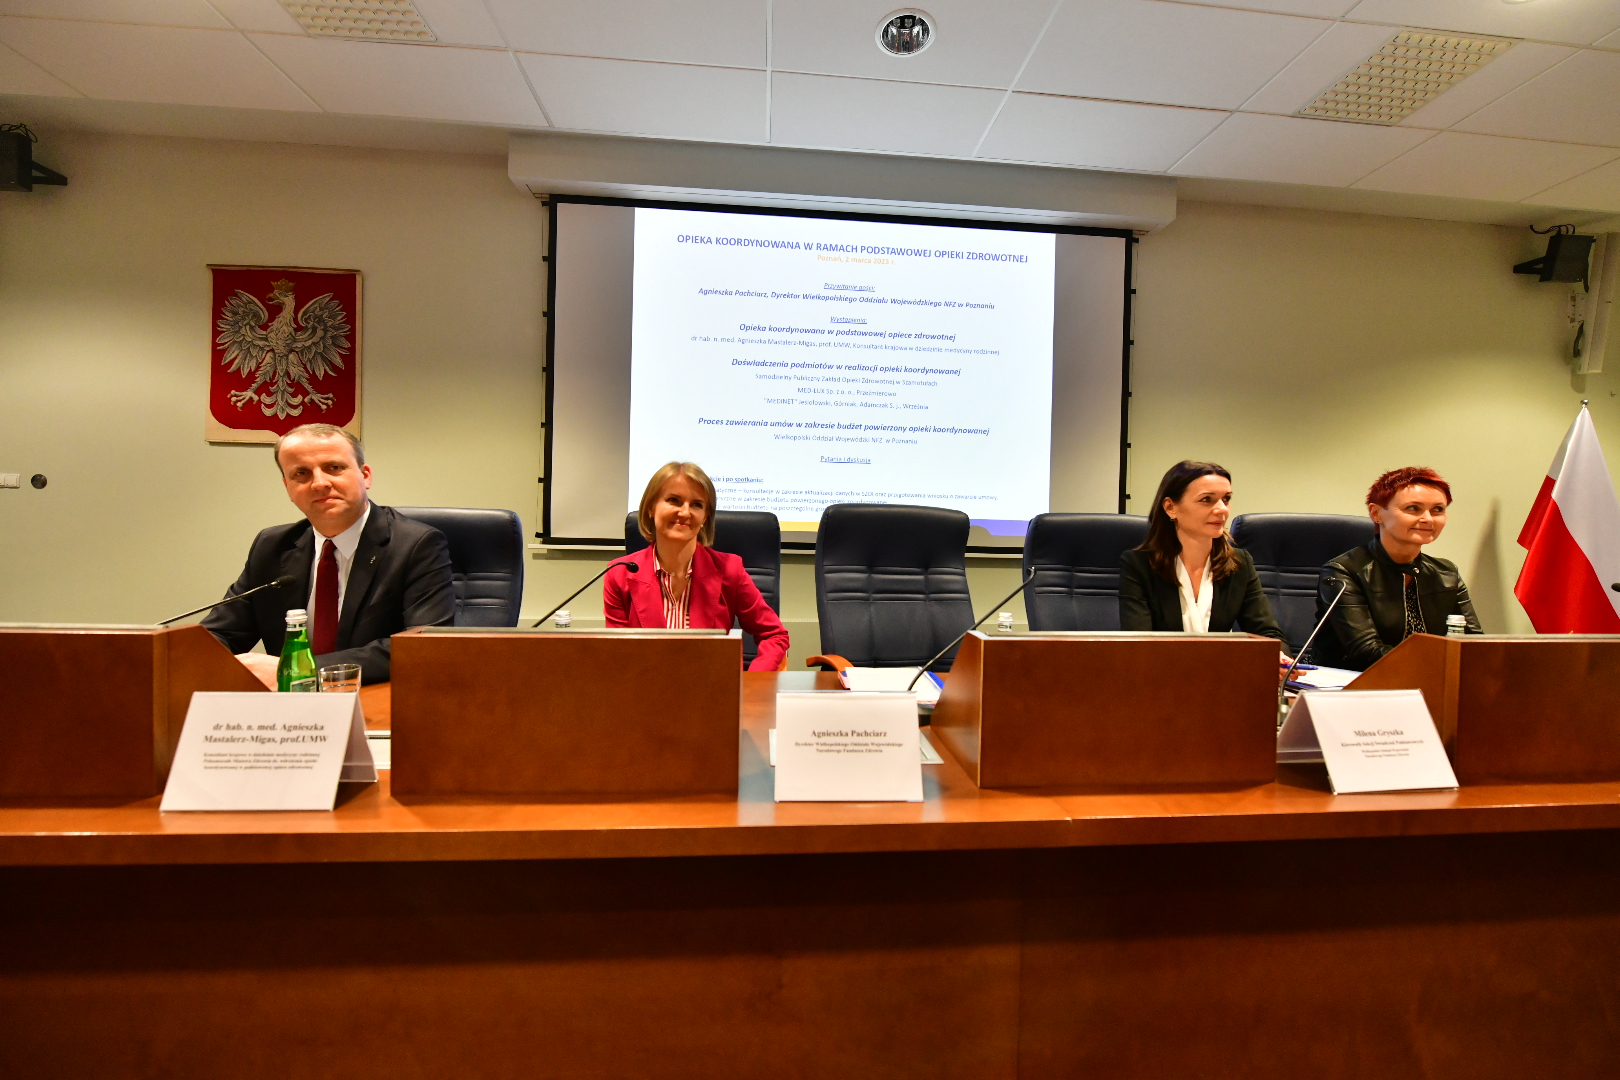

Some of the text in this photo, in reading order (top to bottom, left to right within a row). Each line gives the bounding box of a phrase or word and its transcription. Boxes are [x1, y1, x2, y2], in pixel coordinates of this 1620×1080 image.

[677, 234, 712, 244] OPIEKA
[716, 237, 800, 250] KOORDYNOWANA
[816, 243, 858, 253] RAMACH
[860, 246, 932, 258] PODSTAWOWEJ
[934, 250, 964, 259] OPIEKI
[966, 252, 1028, 263] ZDROWOTNEJ
[817, 254, 843, 262] Poznań,
[698, 288, 733, 296] Agnieszka
[735, 289, 768, 298] Pachciarz,
[771, 291, 800, 300] Dyrektor
[802, 293, 858, 303] Wielkopolskiego
[890, 298, 942, 307] Wojewódzkiego
[740, 324, 766, 332] Opieka
[769, 325, 825, 335] koordynowana
[836, 328, 887, 339] podstawowej
[888, 331, 912, 340] opiece
[914, 331, 956, 342] zdrowotnej
[768, 339, 817, 347] Mastalerz-Migas,
[732, 359, 788, 368] Doświadczenia
[790, 361, 834, 370] podmiotów
[845, 364, 878, 373] realizacji
[879, 365, 902, 374] opieki
[904, 366, 961, 376] koordynowanej
[755, 374, 792, 382] Samodzielny
[837, 422, 862, 430] budżet
[864, 424, 907, 433] powierzony
[908, 425, 931, 434] opieki
[933, 426, 989, 436] koordynowanej
[280, 723, 324, 732] Agnieszka
[811, 730, 848, 738] Agnieszka
[1377, 729, 1404, 737] Gryszka
[204, 735, 278, 744] Mastalerz-Migas,
